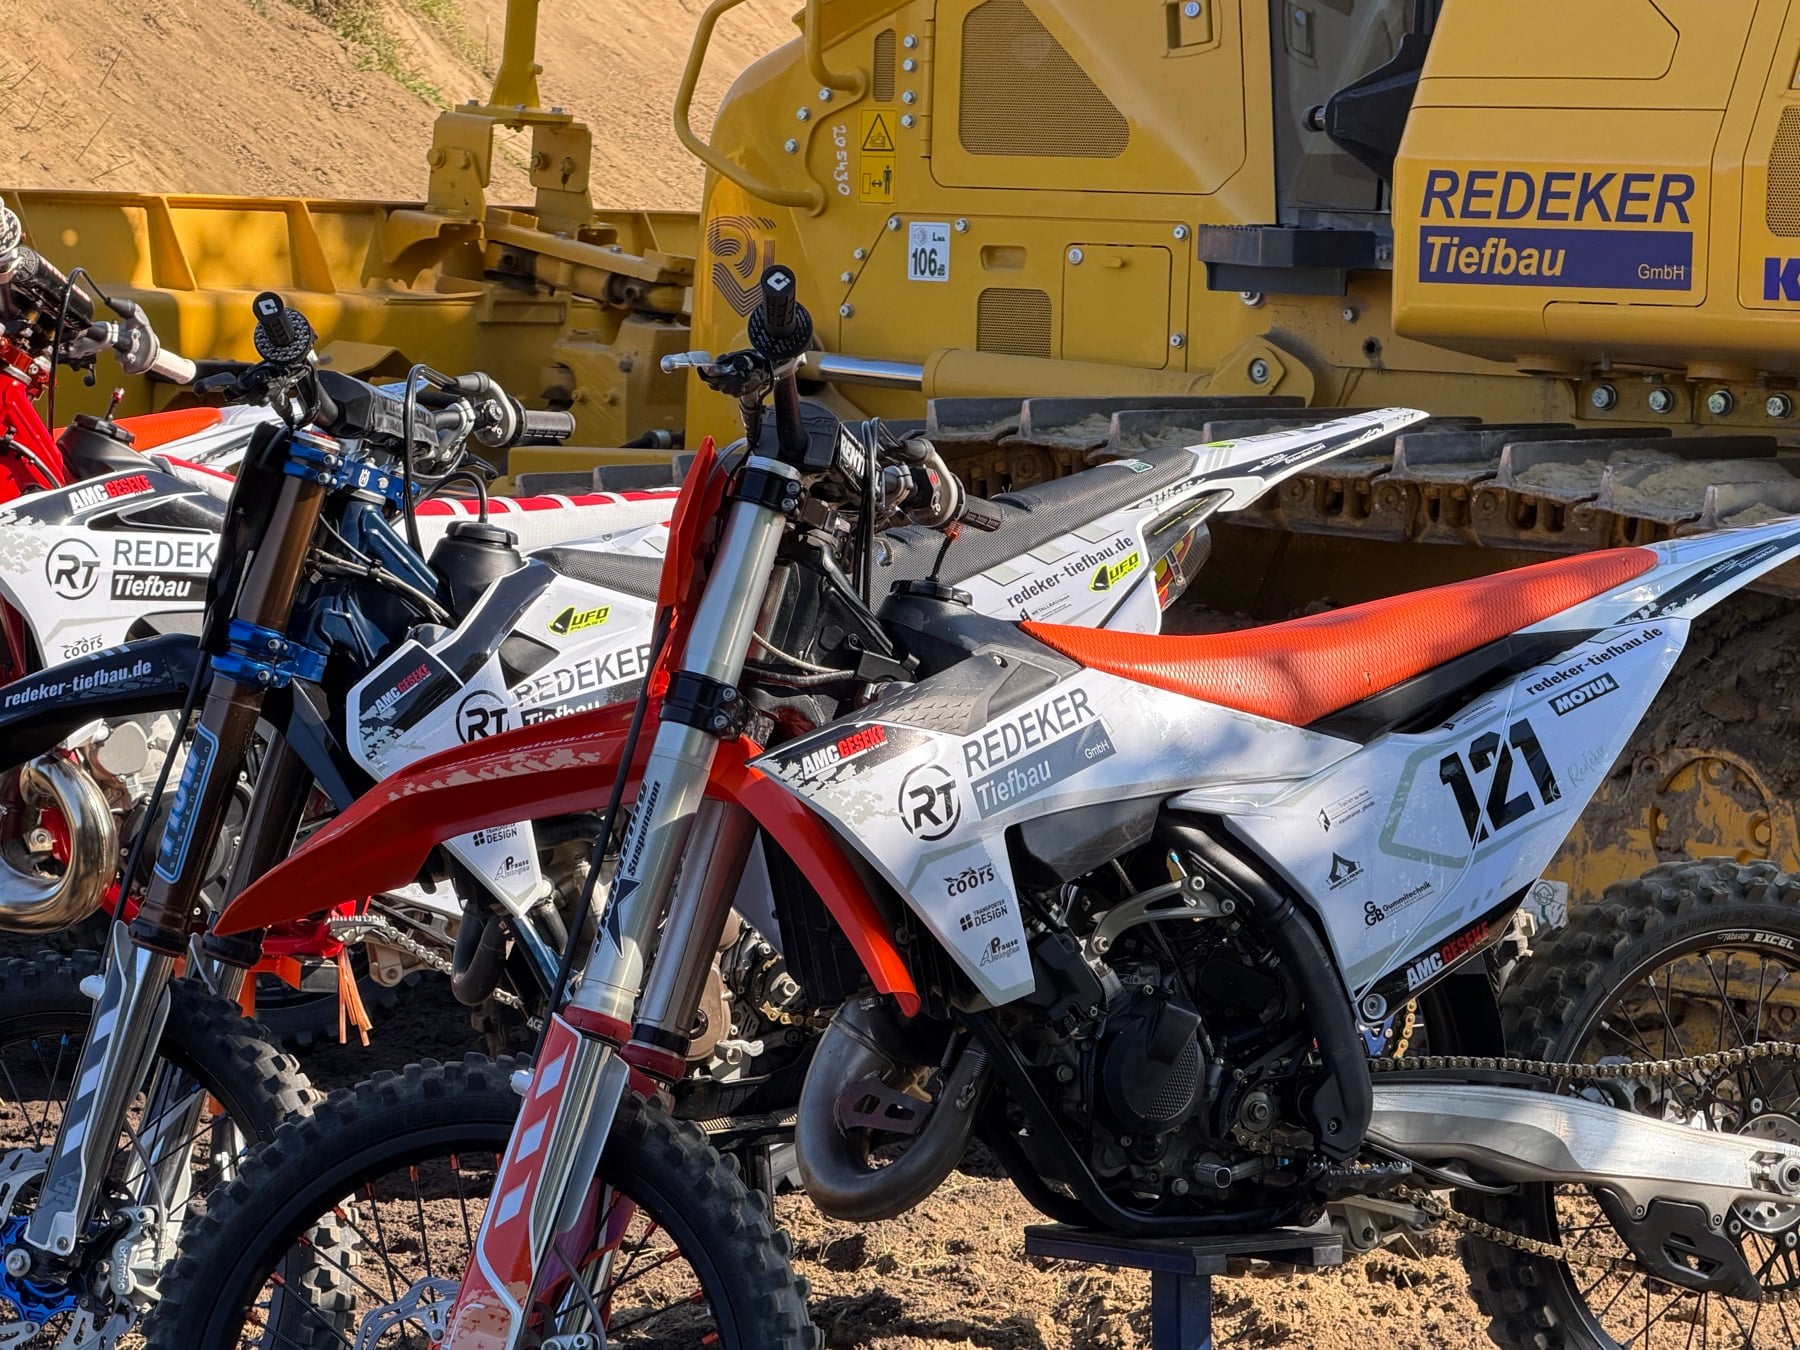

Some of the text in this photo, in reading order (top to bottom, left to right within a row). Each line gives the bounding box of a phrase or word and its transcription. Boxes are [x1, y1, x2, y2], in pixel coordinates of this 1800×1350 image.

[1420, 169, 1696, 225] REDEKER
[912, 247, 938, 277] 106
[1426, 236, 1685, 281] Tiefbau GmbH
[1007, 535, 1134, 609] redeker-tiefbau.de
[1109, 552, 1139, 579] UFO
[115, 574, 192, 598] Tiefbau
[570, 606, 610, 626] UFO
[62, 636, 103, 660] coors
[1525, 626, 1664, 696] redeker-tiefbau.de
[4, 659, 152, 708] redeker-tiefbau.de
[1556, 680, 1616, 715] MOTUL
[962, 687, 1096, 778] REDEKER
[976, 739, 1111, 811] Tiefbau GmbH
[1439, 718, 1562, 844] 121
[627, 780, 662, 877] Suspension
[947, 867, 995, 897] coors
[1382, 880, 1432, 912] Gummitechnik
[973, 898, 1006, 916] TRANSPORTER
[974, 905, 1008, 927] DESIGN
[990, 936, 1019, 954] Prause
[1753, 932, 1795, 950] EXCEL
